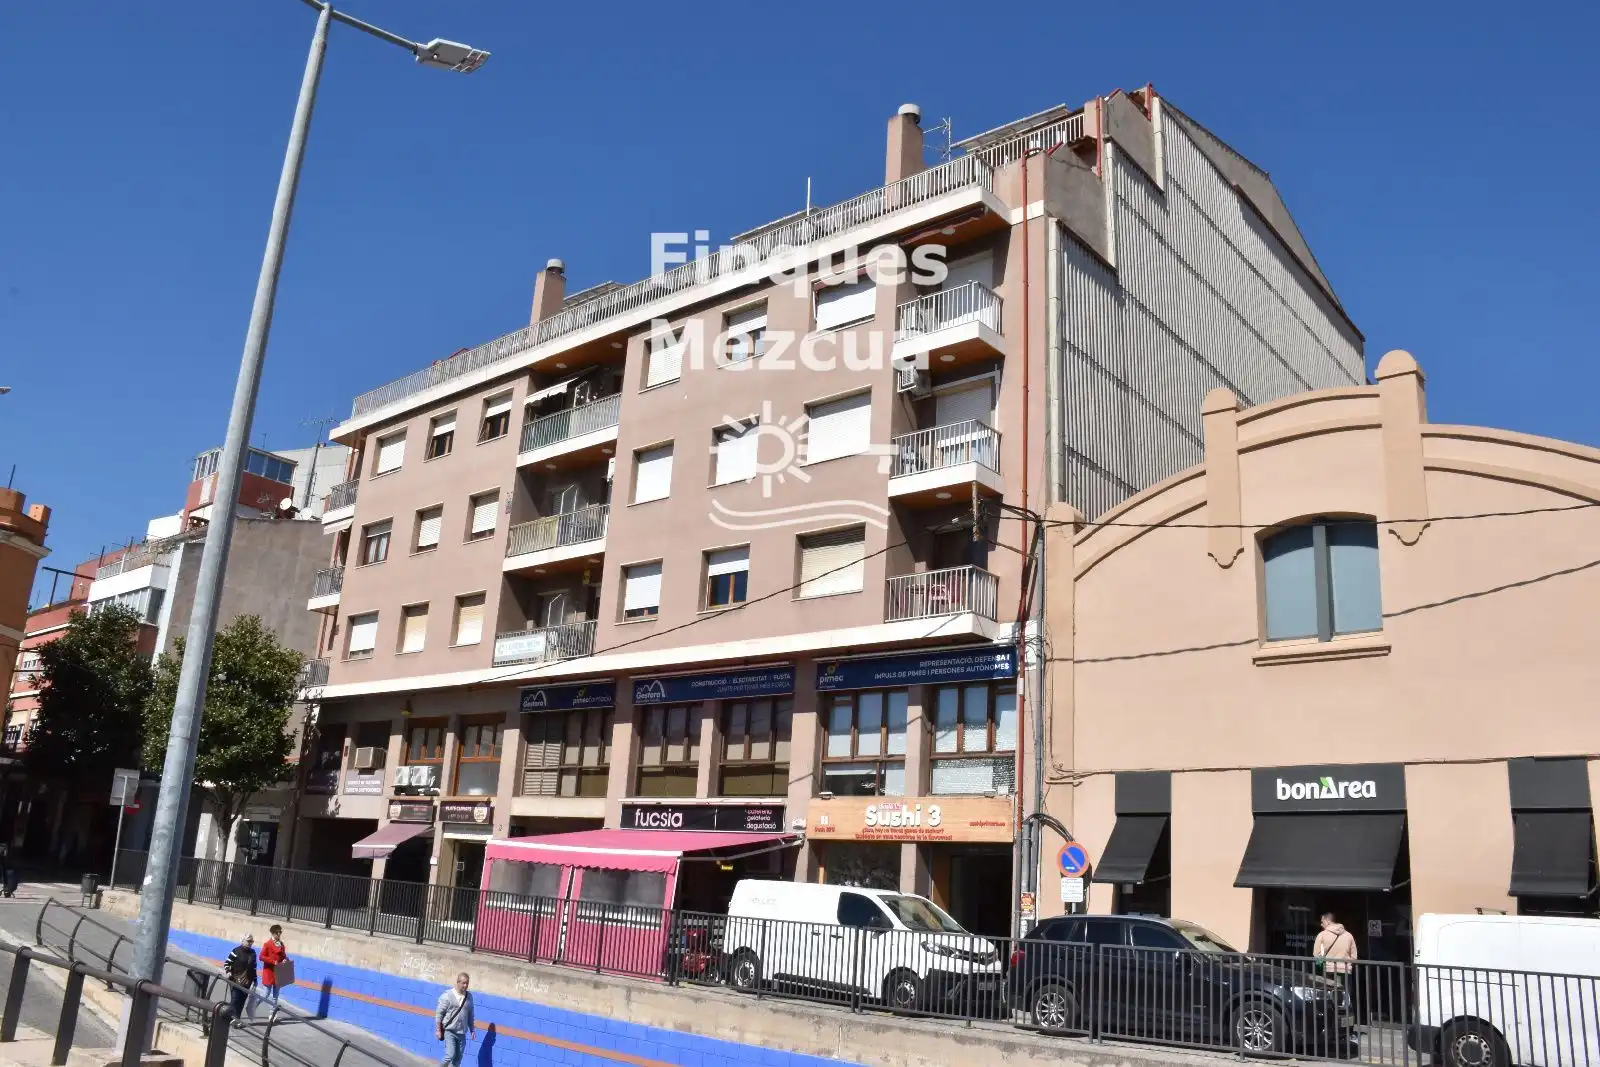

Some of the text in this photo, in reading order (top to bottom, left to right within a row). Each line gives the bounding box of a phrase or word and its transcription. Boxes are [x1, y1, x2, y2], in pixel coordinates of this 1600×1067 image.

[974, 654, 1006, 664] DEFENSA
[874, 670, 897, 680] IMPULS
[897, 670, 907, 678] DE
[907, 668, 927, 678] PIMES
[930, 665, 965, 676] PERSONES
[965, 661, 1010, 673] AUTÒNOMES
[819, 672, 844, 686] pimec
[635, 691, 661, 700] Gestora
[635, 808, 683, 828] fucsia
[865, 803, 942, 828] Sushi 3
[746, 822, 776, 831] degustació
